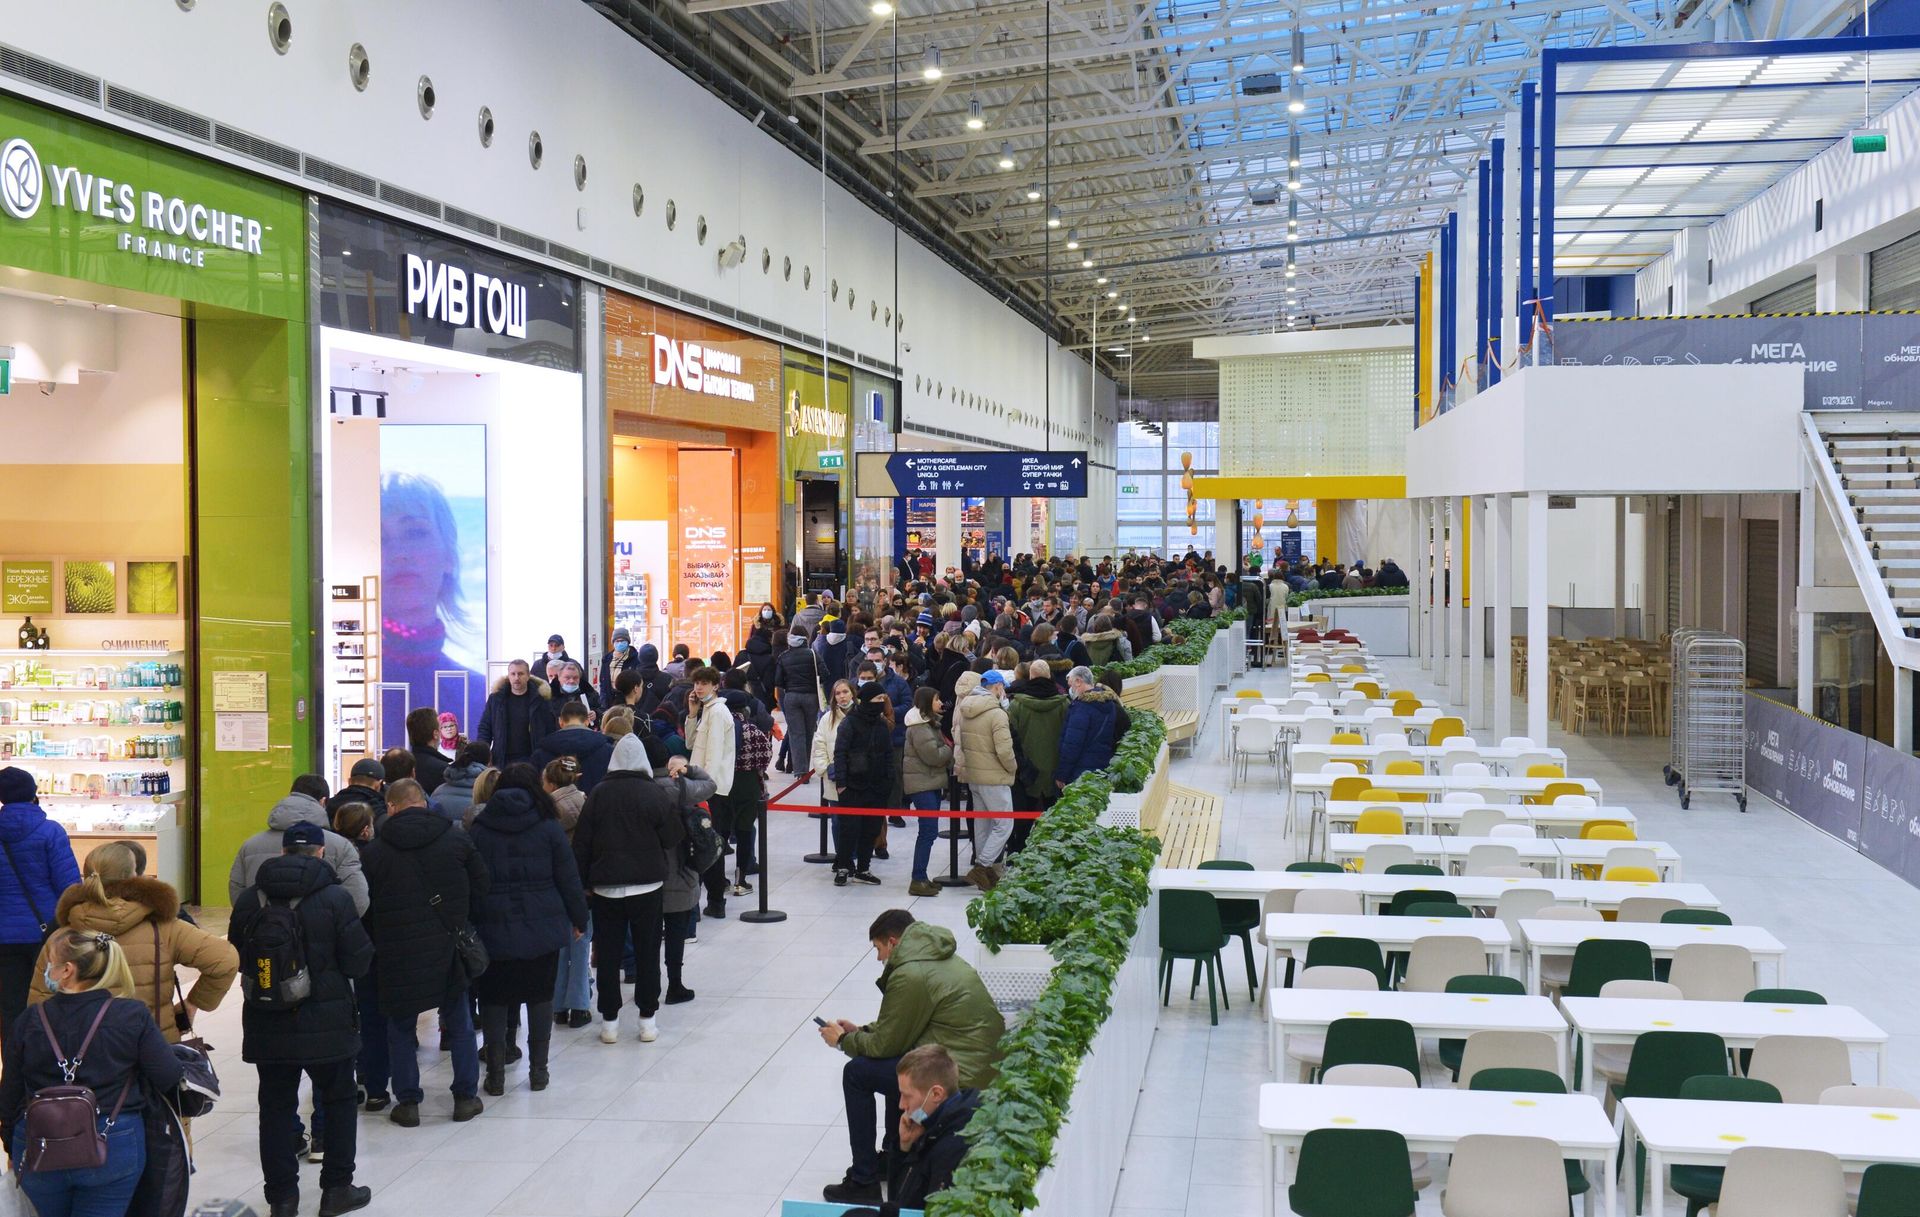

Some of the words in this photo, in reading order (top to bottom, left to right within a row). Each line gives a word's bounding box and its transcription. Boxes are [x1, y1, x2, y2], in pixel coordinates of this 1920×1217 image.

[46, 164, 136, 224] YVES
[142, 191, 262, 255] ROCHER
[118, 232, 205, 268] FRANCE
[405, 253, 469, 326] РИВ
[472, 272, 527, 339] ГОШ
[1751, 343, 1806, 359] МЕГА
[653, 333, 704, 392] DNS
[1022, 463, 1050, 471] ДЕТСКИЙ
[685, 527, 727, 539] DNS
[683, 571, 724, 579] ЗАКАЗЫВАЙ
[689, 580, 723, 588] ПОЛУЧАЙ
[7, 594, 29, 605] ЭКО
[101, 639, 170, 651] ОЧИЩЕНИЕ
[1767, 729, 1780, 749] МЕГА
[1832, 759, 1848, 781] МЕГА
[1823, 773, 1856, 802] обновление
